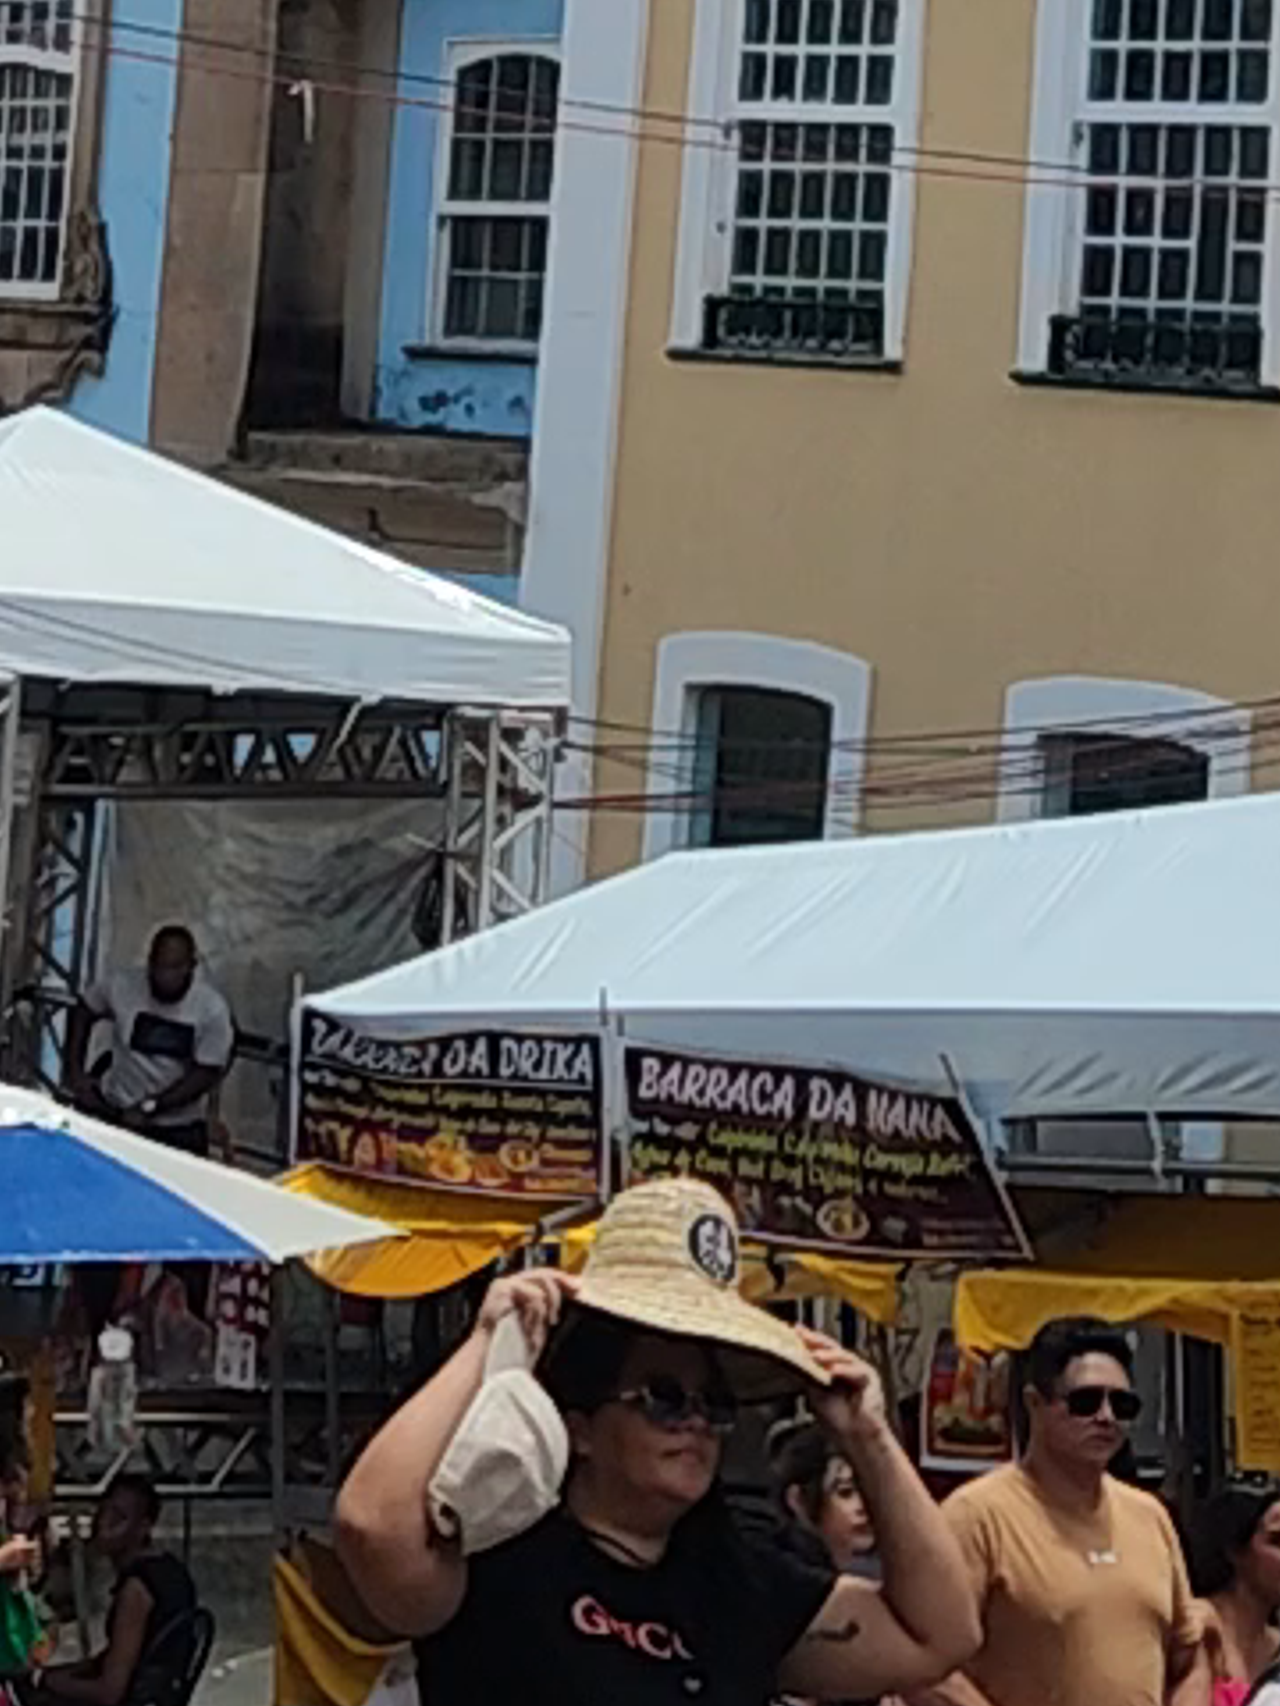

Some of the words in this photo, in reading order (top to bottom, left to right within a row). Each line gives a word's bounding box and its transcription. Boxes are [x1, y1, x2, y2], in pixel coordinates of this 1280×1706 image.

[442, 1036, 490, 1076] DA
[499, 1038, 593, 1081] DRIKA
[637, 1057, 796, 1119] BARRACA
[808, 1078, 856, 1128] DA
